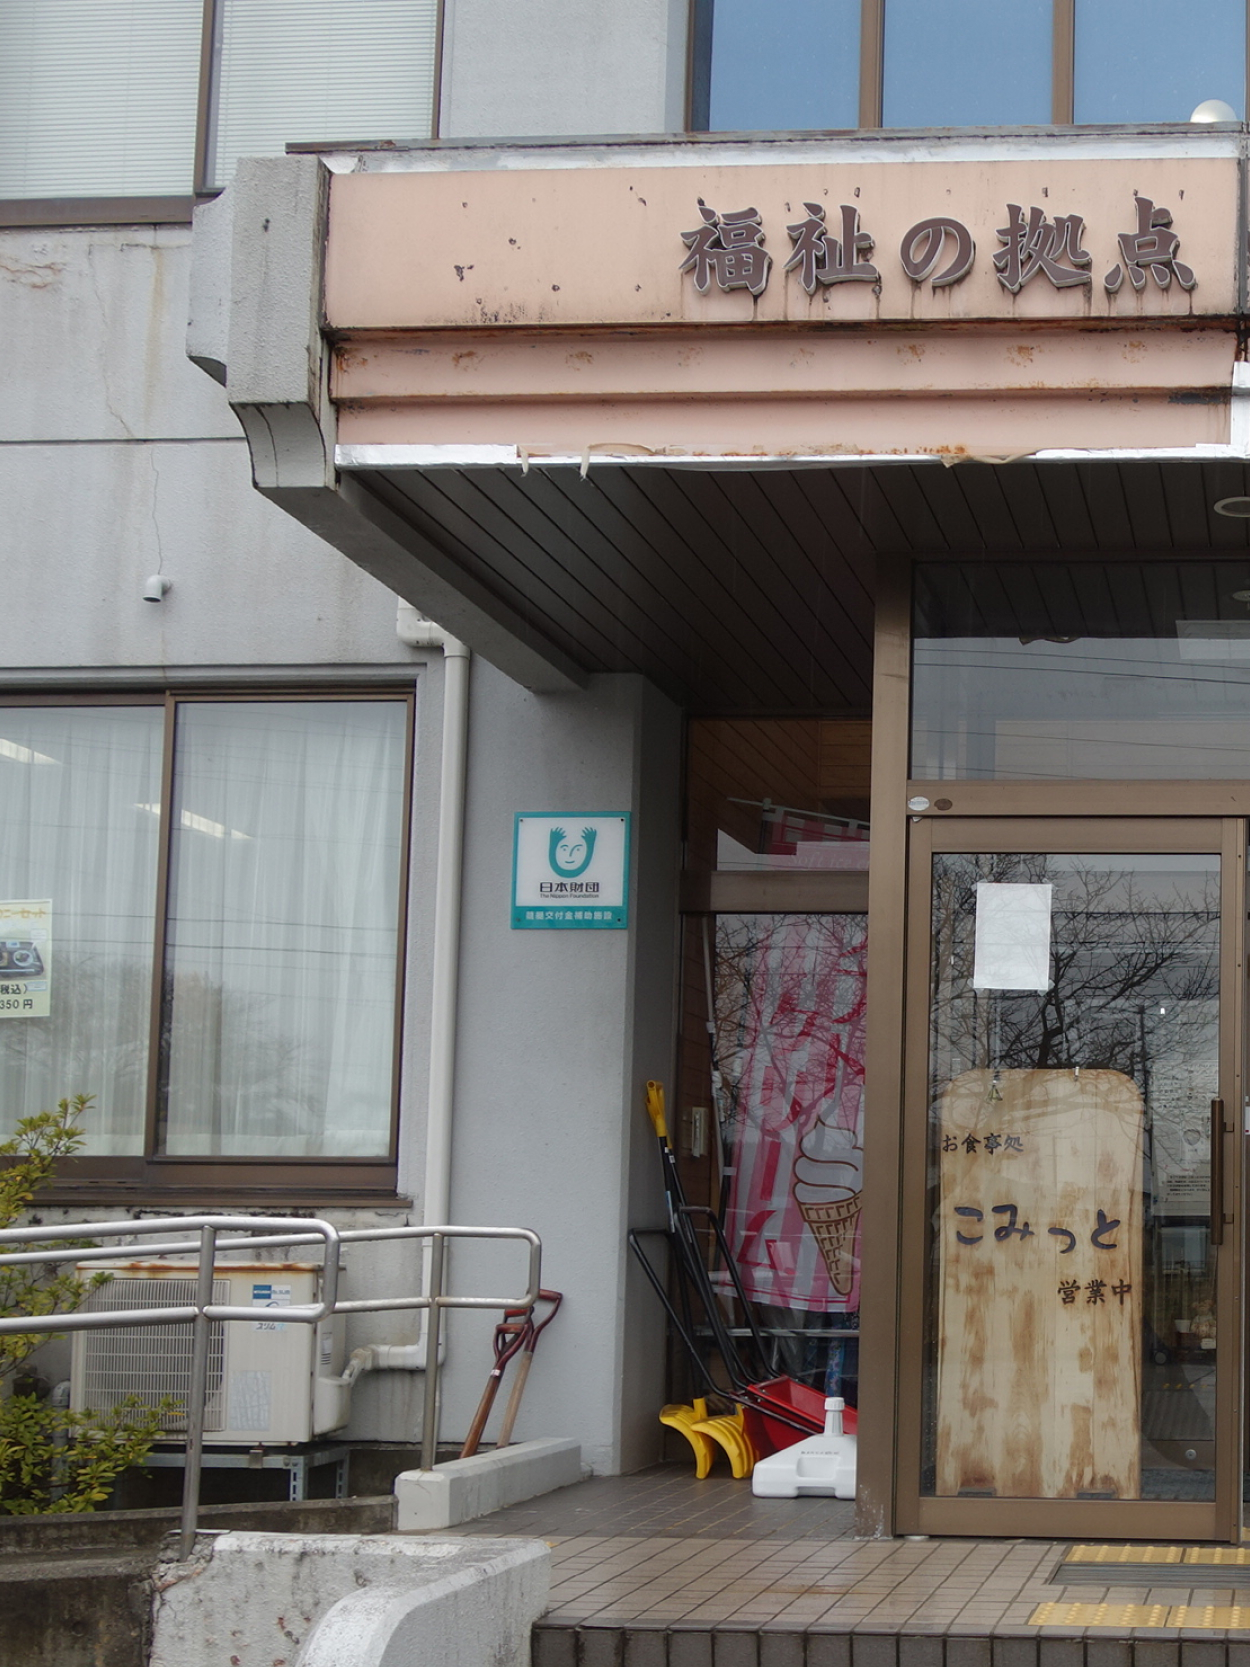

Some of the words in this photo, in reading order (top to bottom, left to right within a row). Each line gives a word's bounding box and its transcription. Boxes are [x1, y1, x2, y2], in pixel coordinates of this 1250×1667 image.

[679, 195, 1199, 297] 福祉の拠点
[539, 881, 600, 893] 日本財団
[954, 1203, 1122, 1254] こみっと
[1057, 1278, 1133, 1306] 営業中
